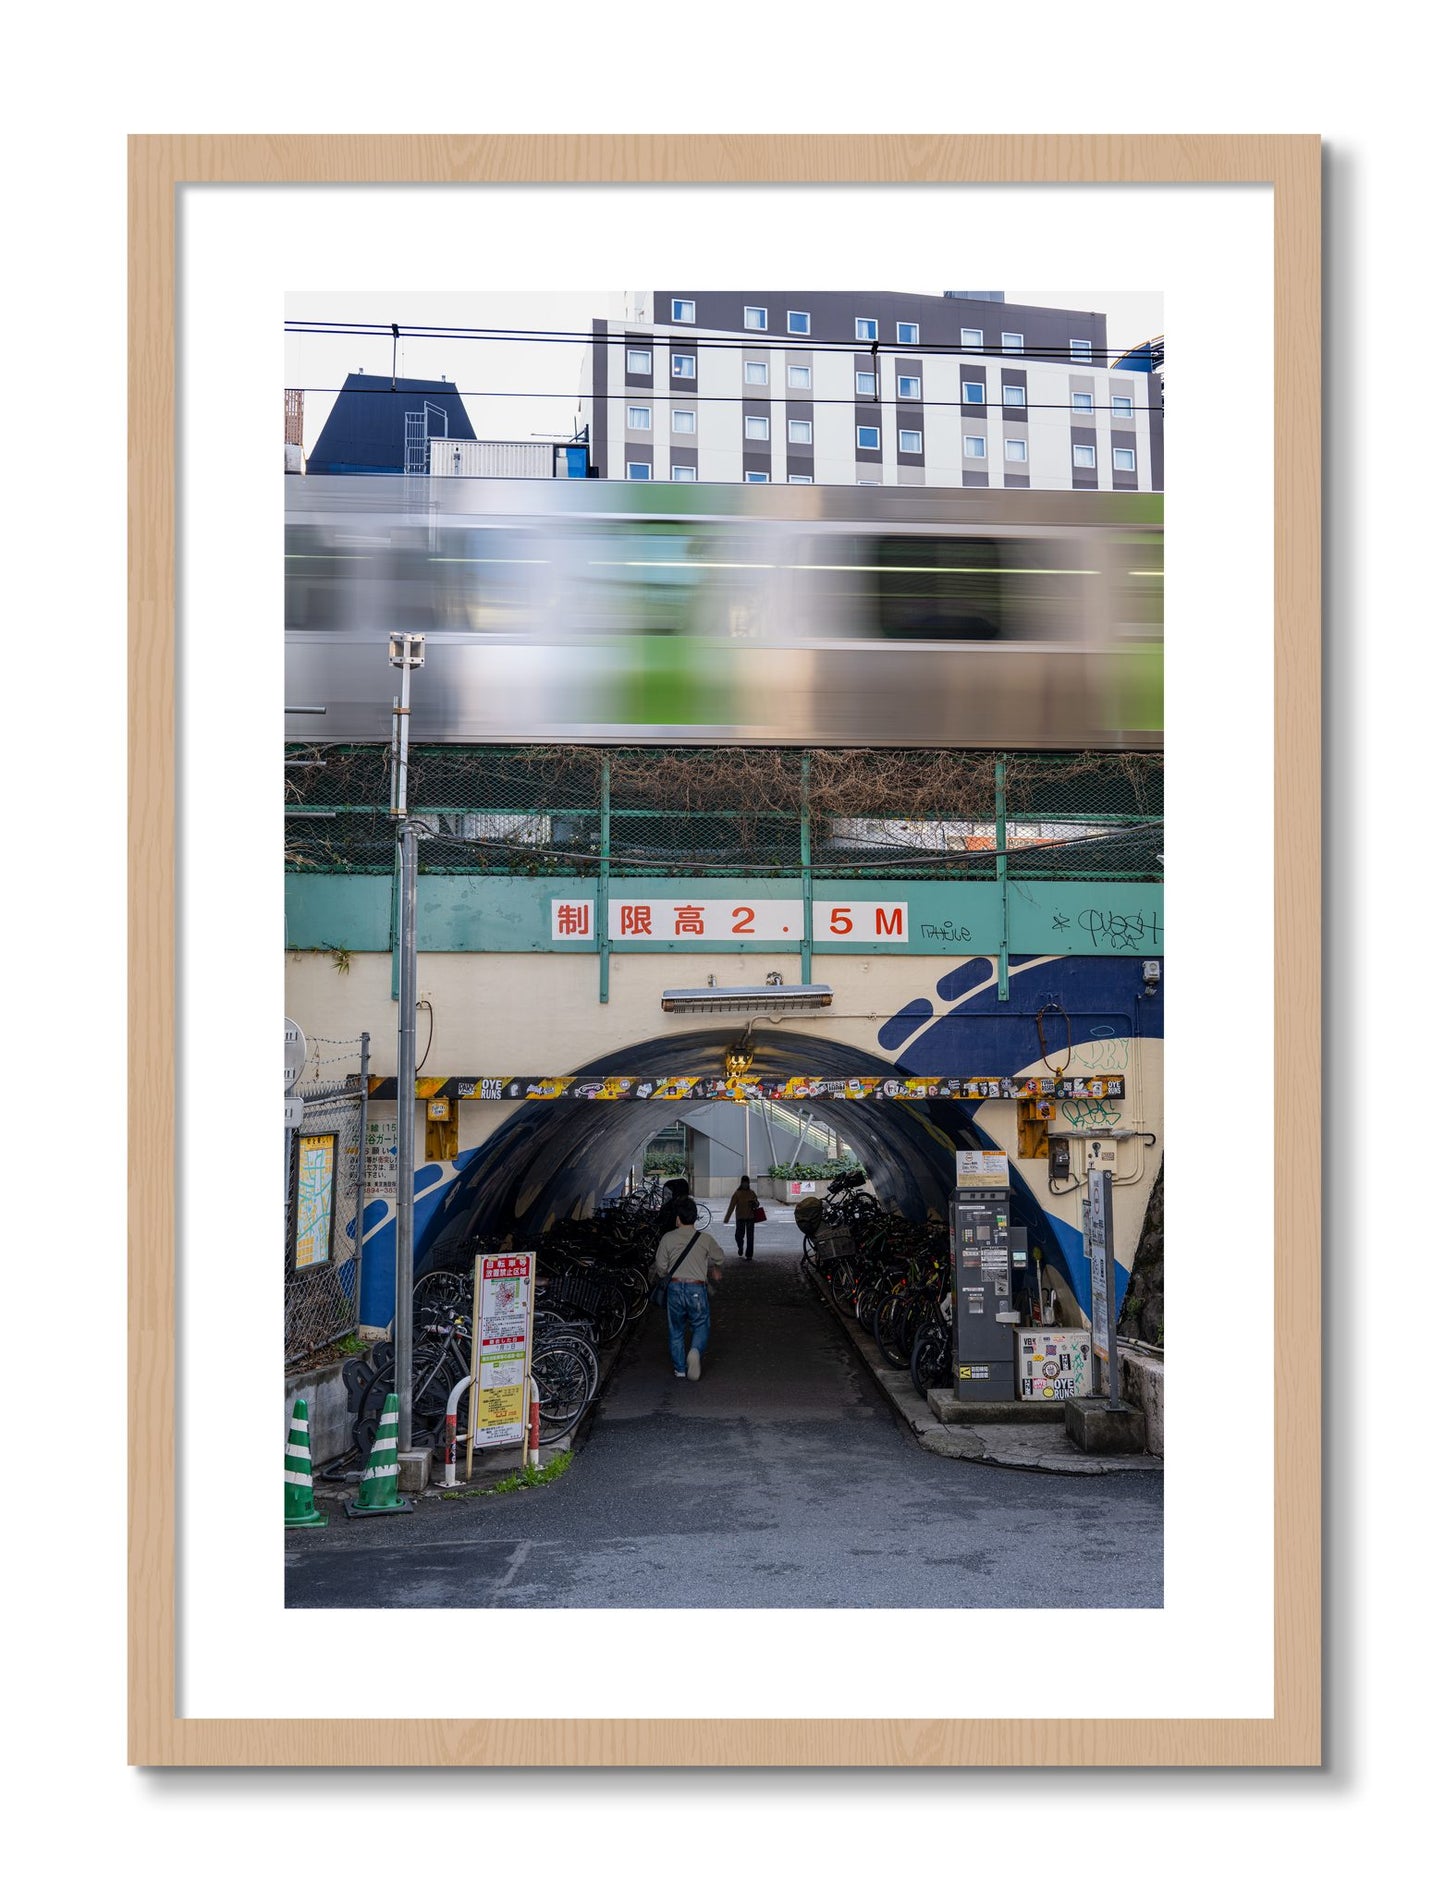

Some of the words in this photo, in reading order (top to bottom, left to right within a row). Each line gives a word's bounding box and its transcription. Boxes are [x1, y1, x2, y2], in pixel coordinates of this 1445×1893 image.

[482, 1079, 502, 1090] OYE
[481, 1089, 502, 1099] RUNS
[1054, 1379, 1074, 1389] OYE
[1054, 1388, 1075, 1399] RUNS
